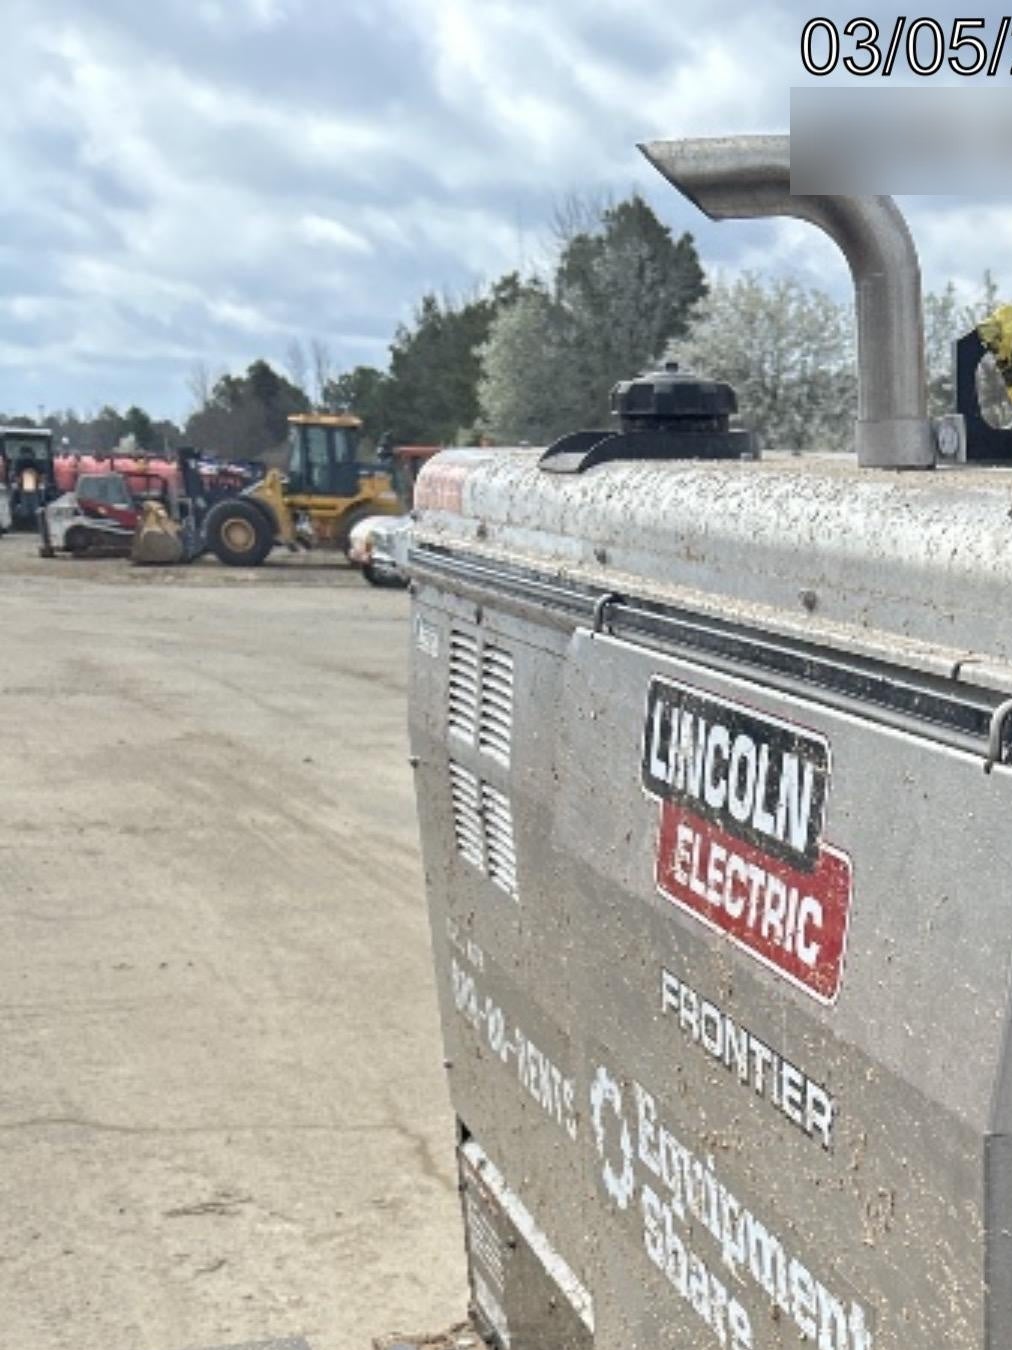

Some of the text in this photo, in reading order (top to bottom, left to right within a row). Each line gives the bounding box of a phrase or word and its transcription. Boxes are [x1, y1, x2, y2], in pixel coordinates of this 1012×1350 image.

[648, 697, 815, 854] LINCOLN
[672, 823, 824, 968] ELECTRIC
[660, 967, 836, 1150] FRONTIER
